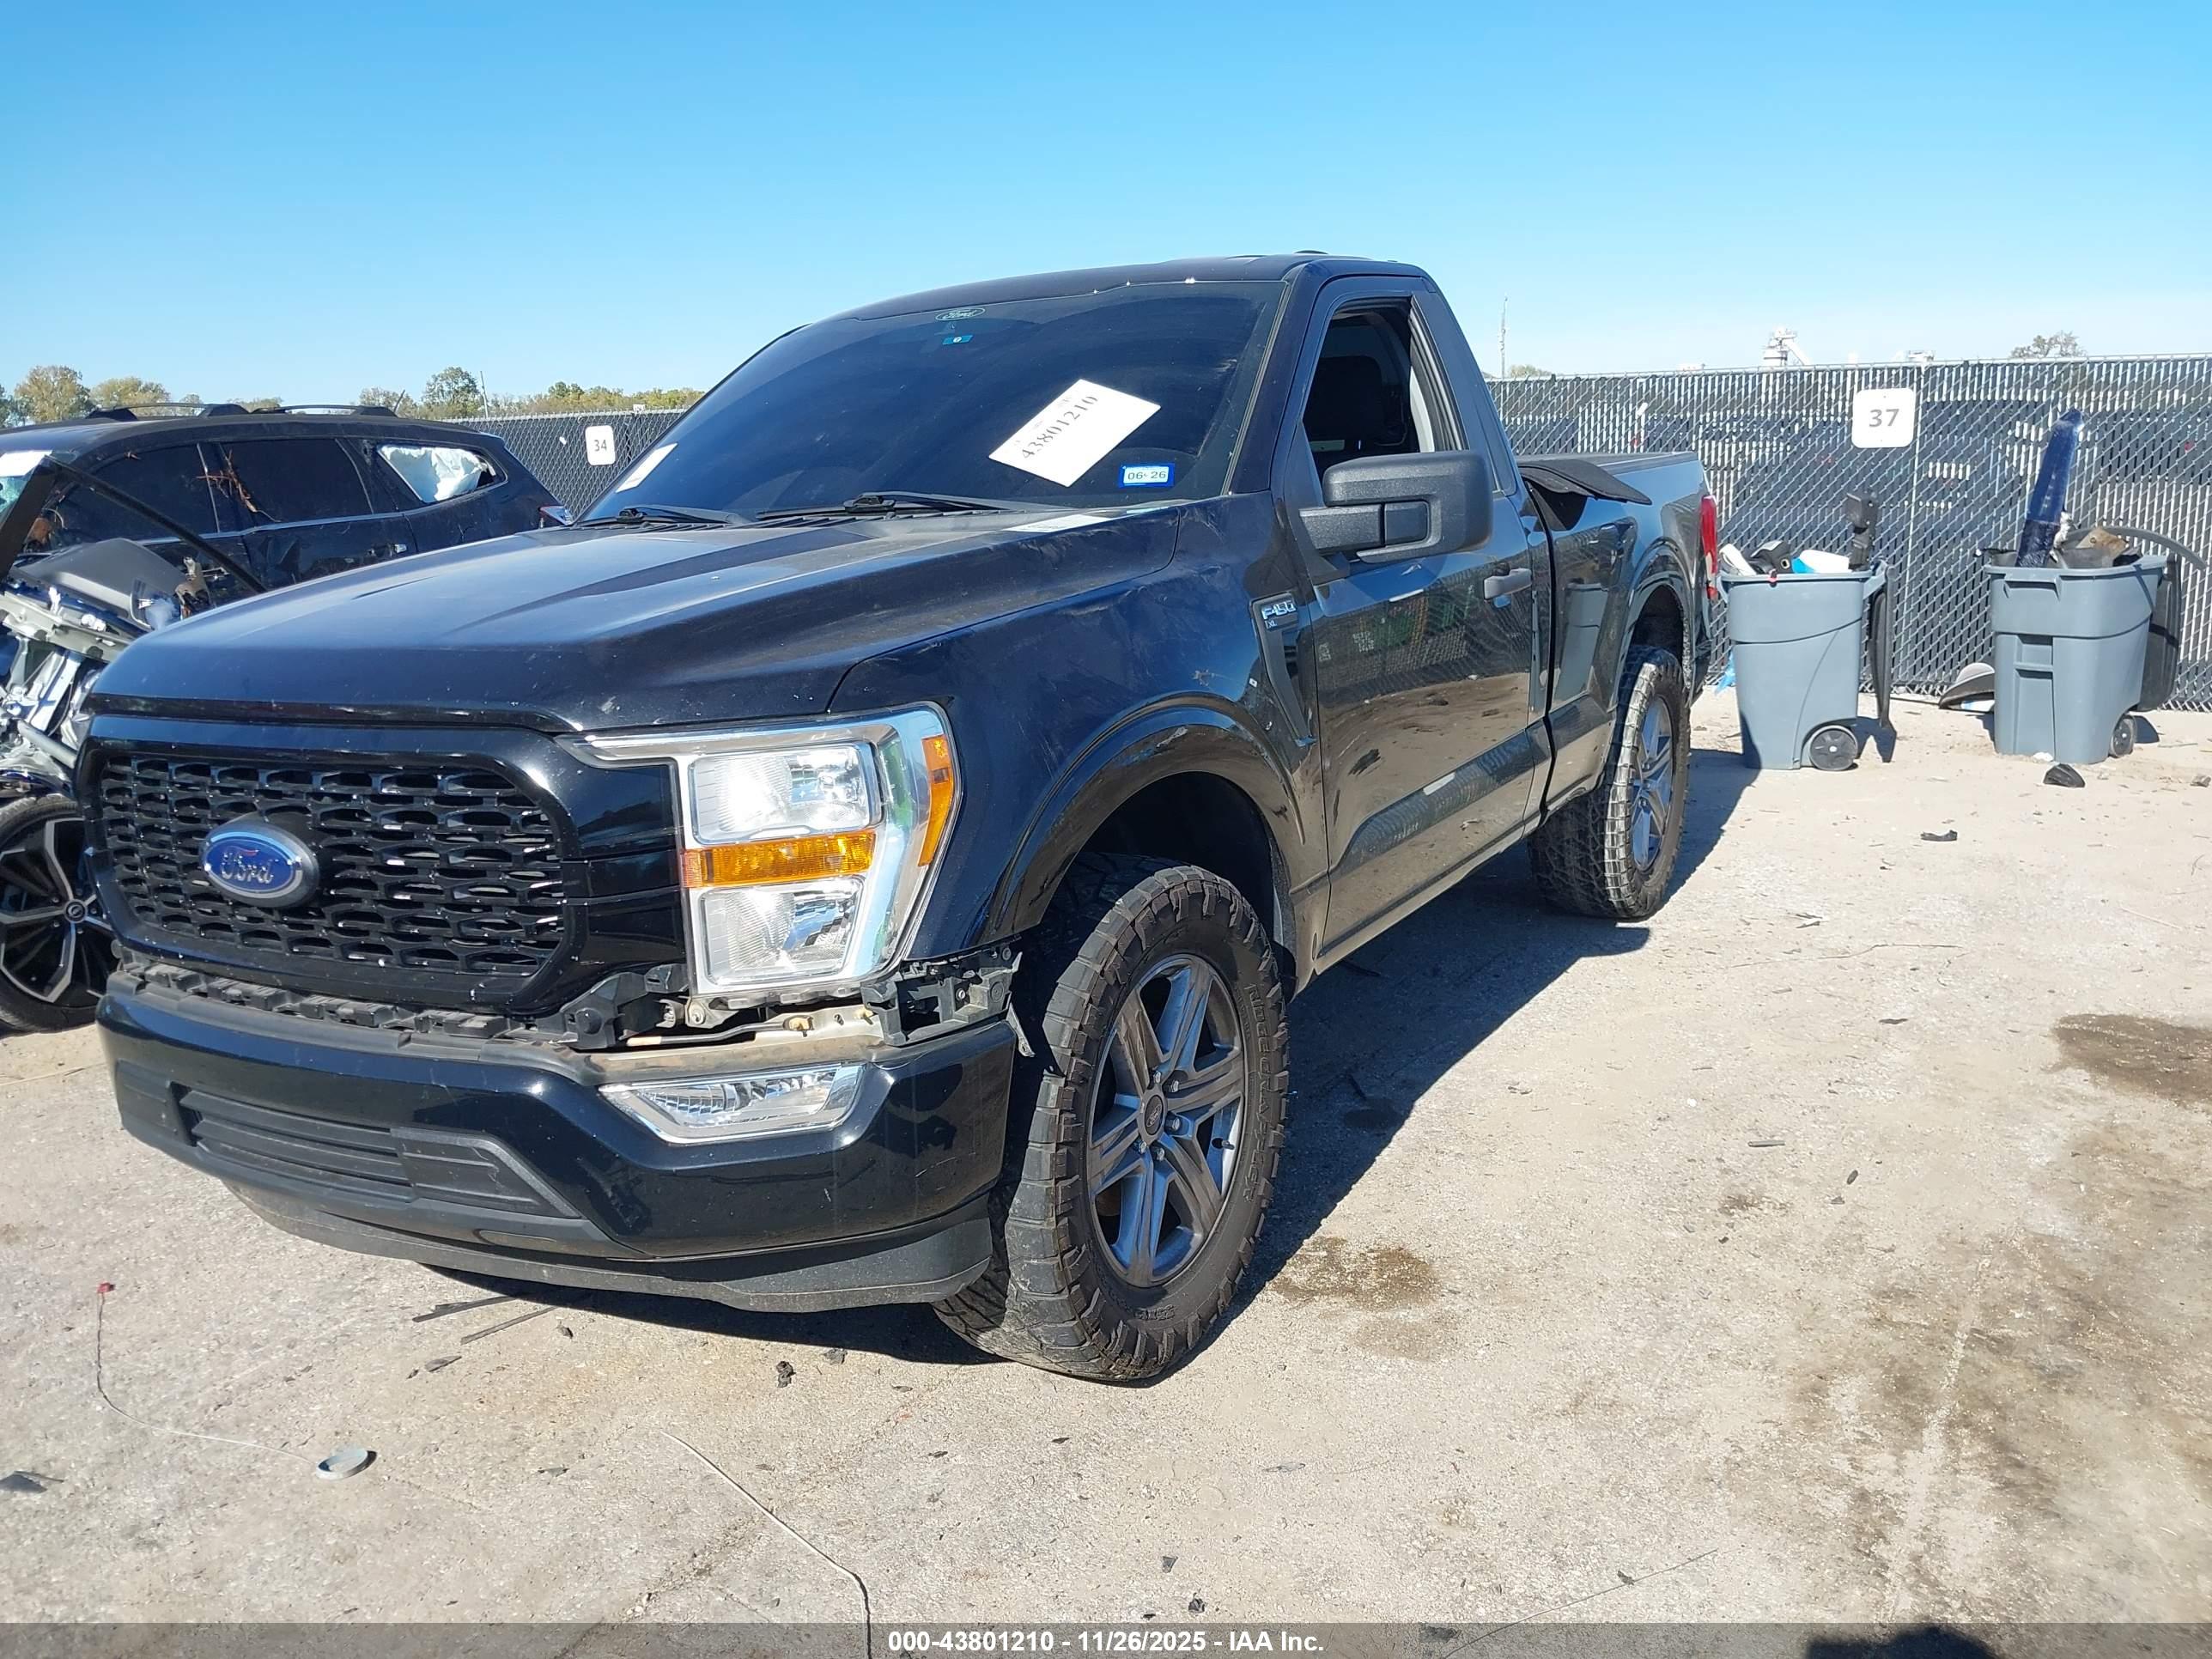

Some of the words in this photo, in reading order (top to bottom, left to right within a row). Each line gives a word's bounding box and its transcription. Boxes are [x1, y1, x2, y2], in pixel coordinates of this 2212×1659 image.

[1022, 396, 1098, 459] 43801210
[1869, 408, 1899, 428] 37
[593, 439, 607, 452] 34
[219, 844, 277, 884] Ford
